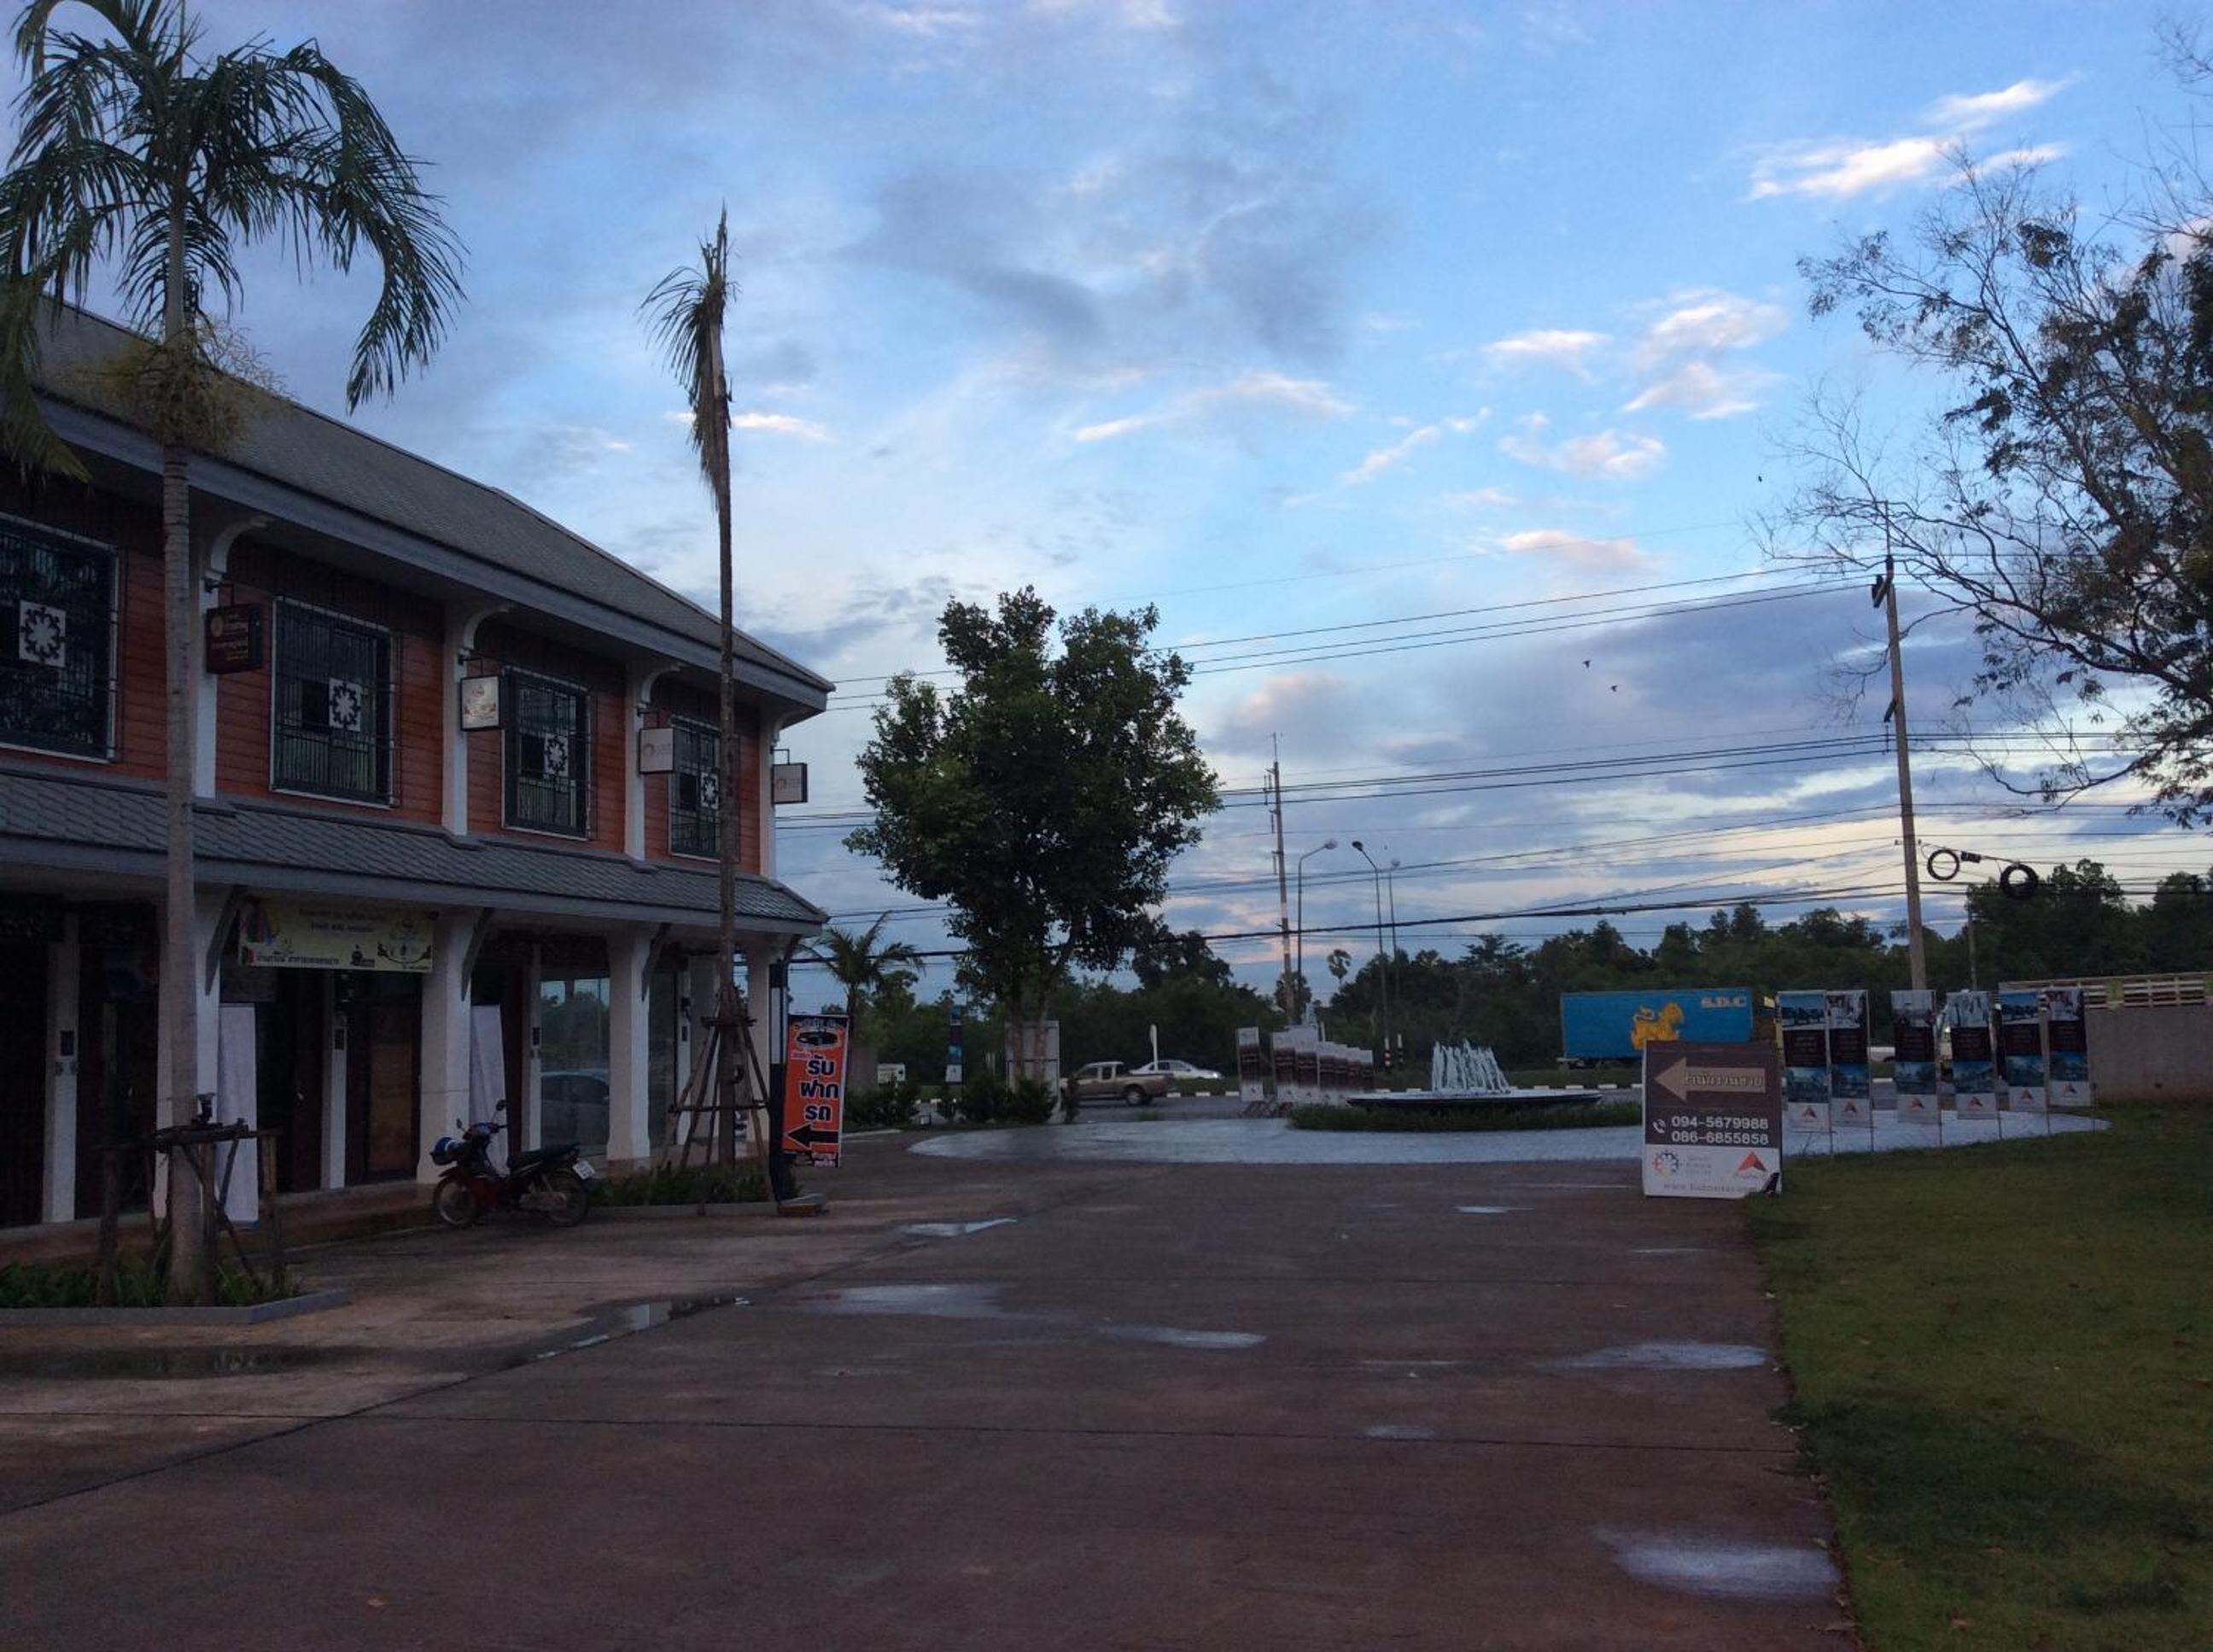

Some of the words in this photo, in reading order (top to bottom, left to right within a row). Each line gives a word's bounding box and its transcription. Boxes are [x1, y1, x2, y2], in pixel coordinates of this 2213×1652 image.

[808, 1054, 834, 1076] รับ
[800, 1079, 838, 1098] ฝาก
[805, 1106, 831, 1121] รถ
